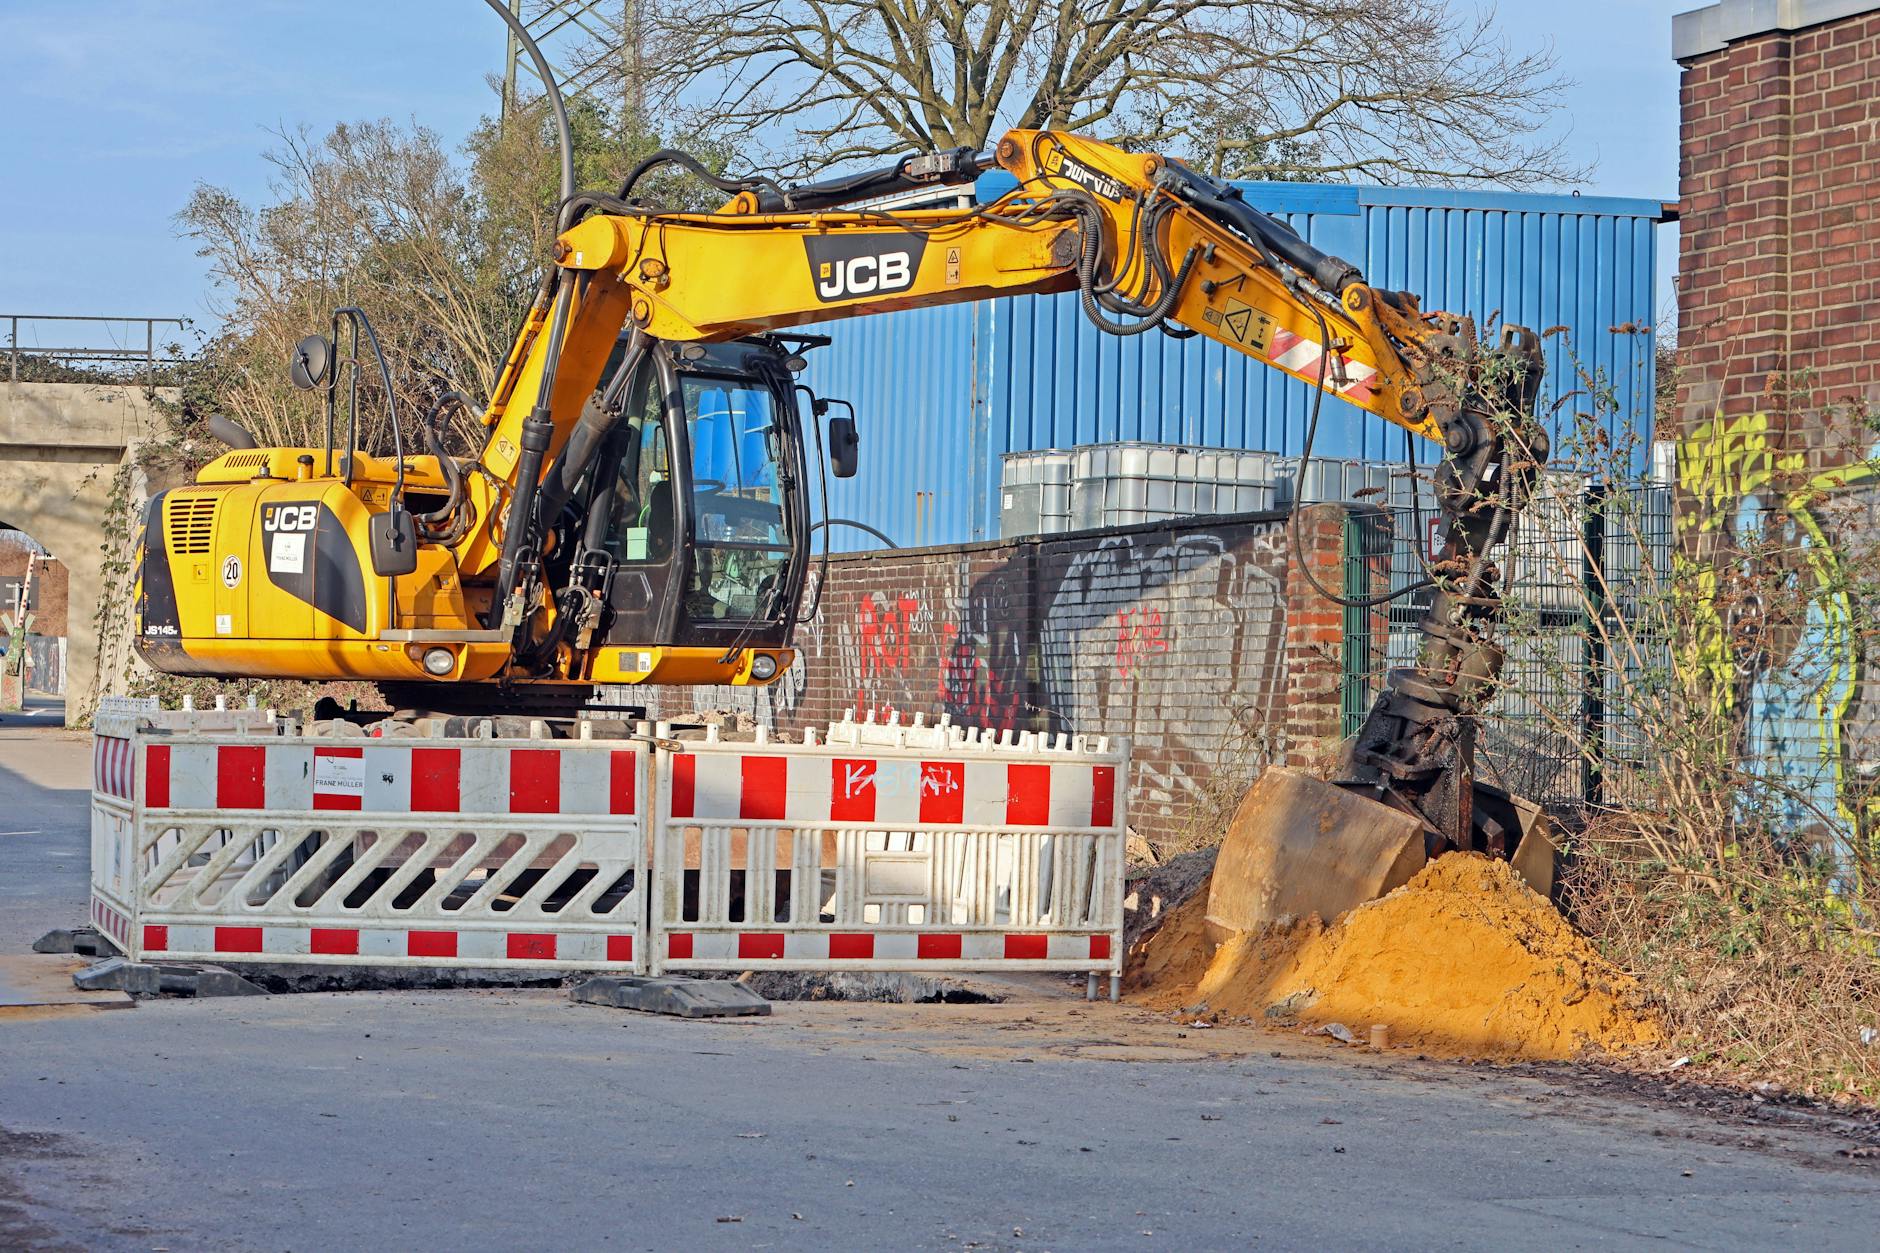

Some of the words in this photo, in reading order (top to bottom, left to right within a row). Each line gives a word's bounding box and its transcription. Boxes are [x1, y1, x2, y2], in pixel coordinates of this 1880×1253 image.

[820, 251, 911, 298] JCB
[264, 506, 317, 532] JCB
[226, 562, 239, 580] 20
